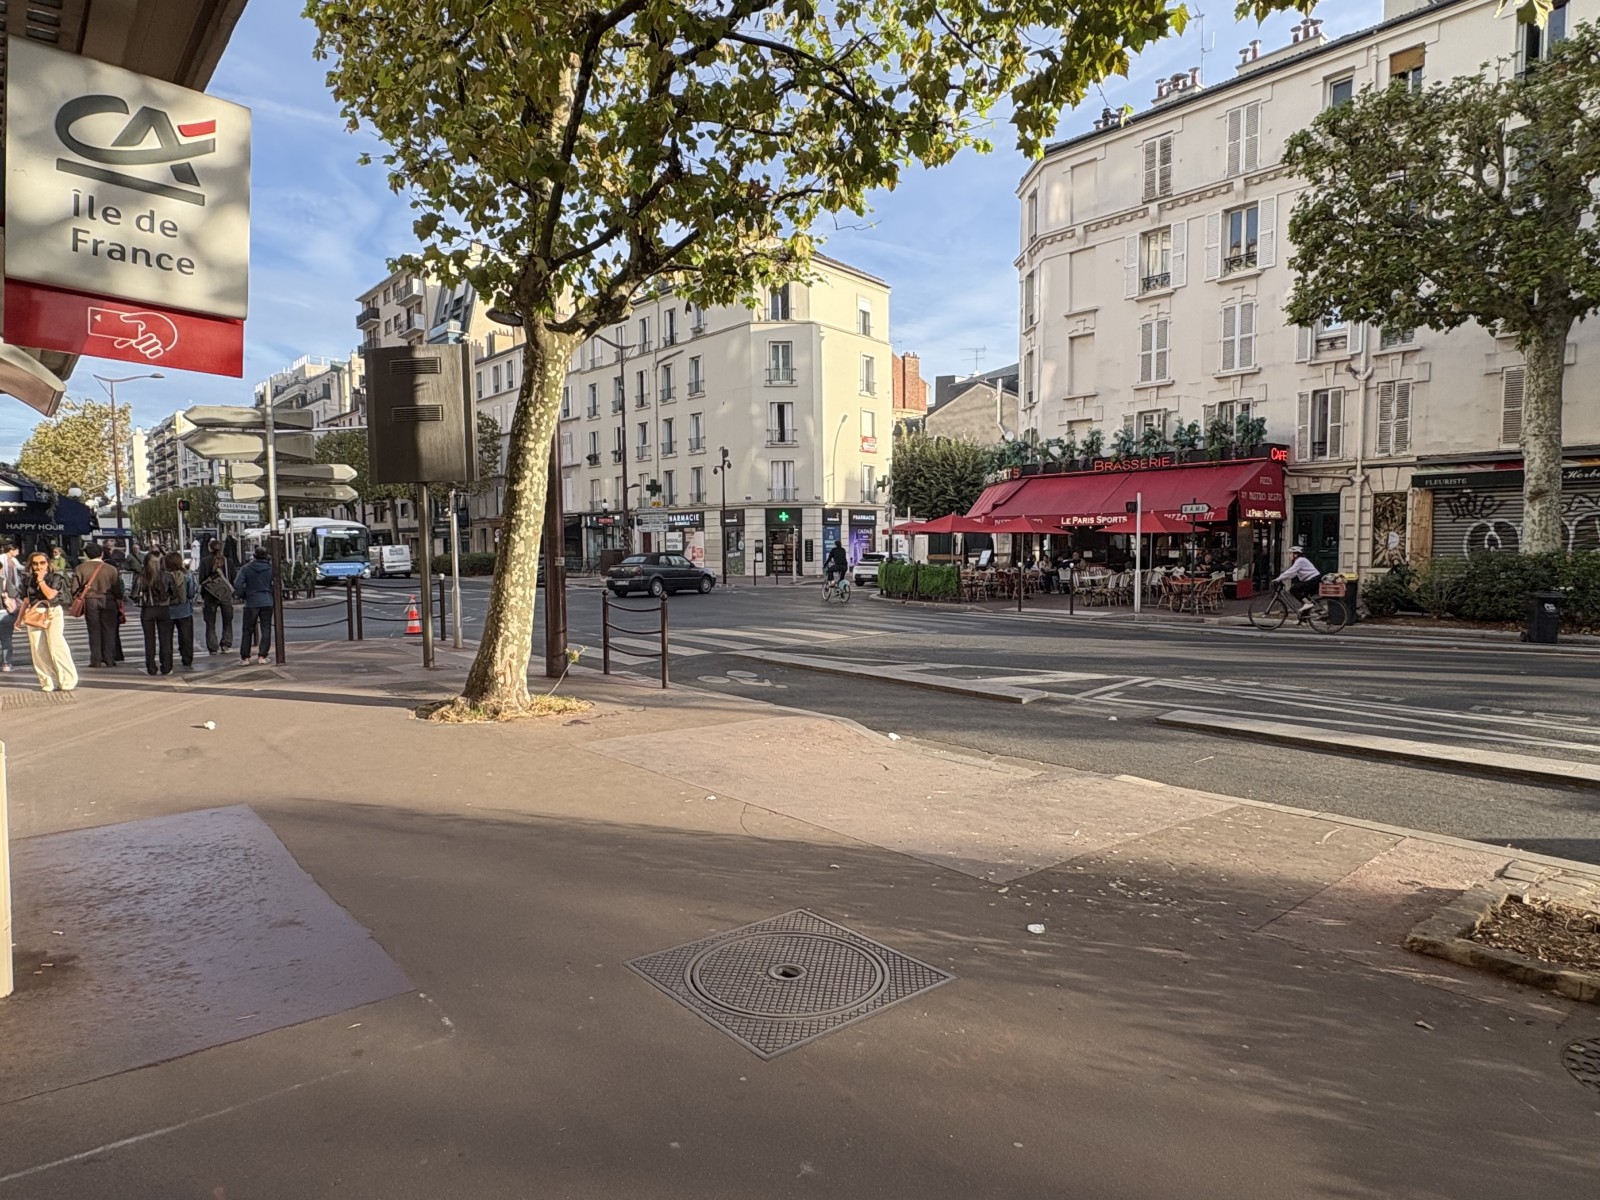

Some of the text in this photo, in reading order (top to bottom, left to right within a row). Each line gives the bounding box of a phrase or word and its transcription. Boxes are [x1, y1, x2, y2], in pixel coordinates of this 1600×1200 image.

[72, 189, 178, 238] Île de
[72, 227, 195, 276] France
[1094, 456, 1171, 472] BRASSERIE
[1425, 477, 1467, 485] FLEURISTE
[669, 513, 699, 522] HARMACIE
[1061, 515, 1127, 525] LE PARIS SPORTS
[6, 523, 65, 531] HAPPY HOUR
